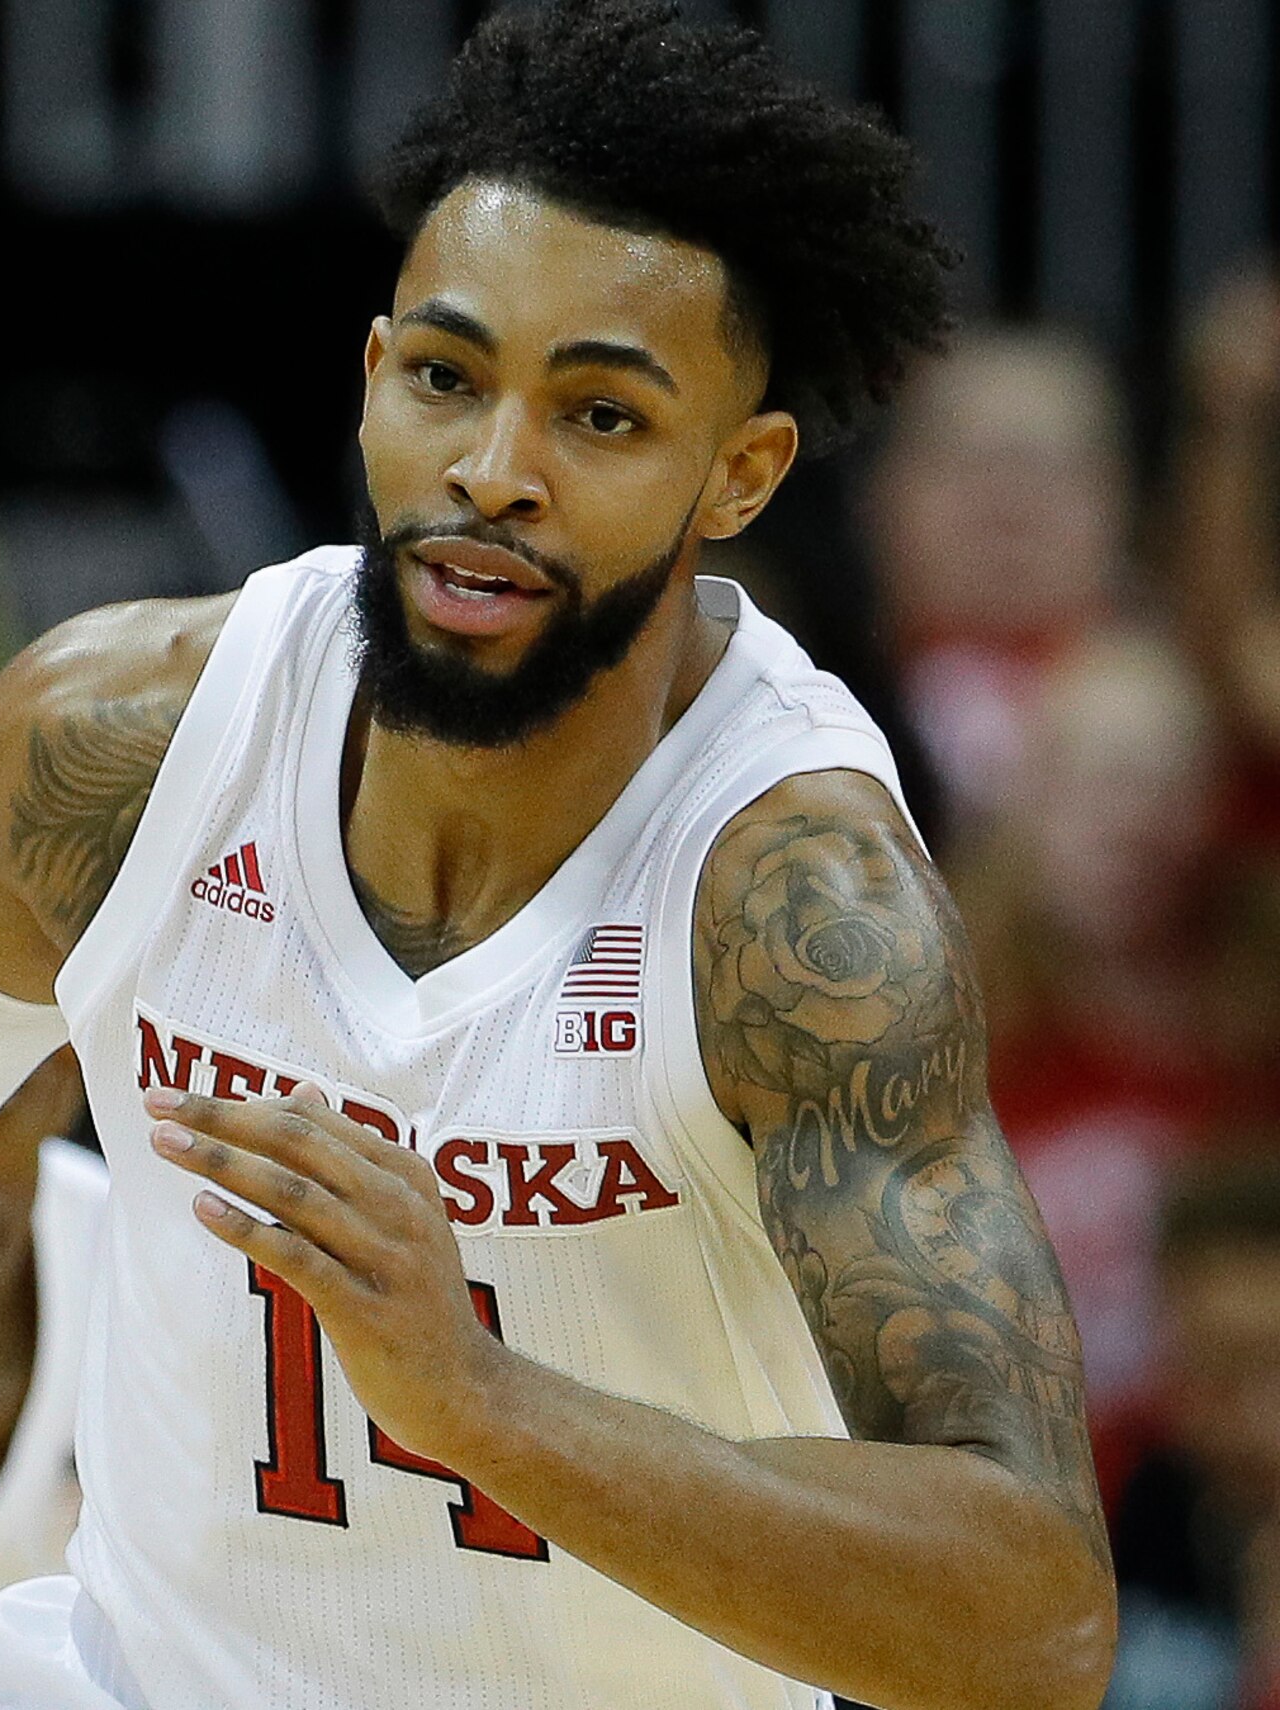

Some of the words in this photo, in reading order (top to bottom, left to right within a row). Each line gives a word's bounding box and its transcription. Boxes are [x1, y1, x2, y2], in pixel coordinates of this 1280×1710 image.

[190, 876, 275, 923] adidas
[136, 1013, 680, 1226] NESKA
[788, 1038, 966, 1190] Mary
